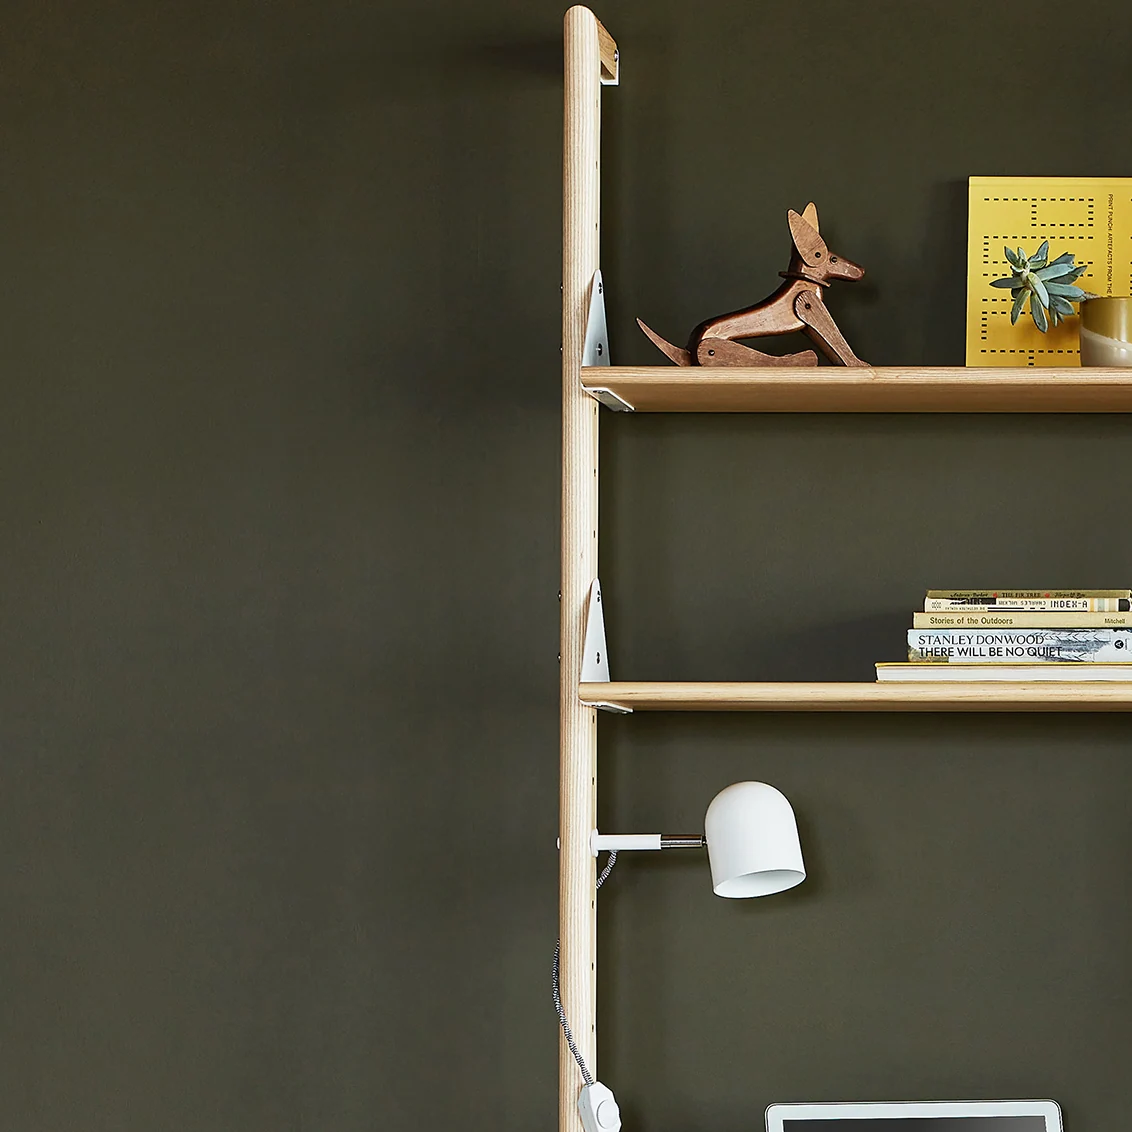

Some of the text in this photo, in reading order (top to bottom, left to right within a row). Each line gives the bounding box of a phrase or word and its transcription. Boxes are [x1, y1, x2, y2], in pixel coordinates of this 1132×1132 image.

[1050, 600, 1088, 608] INDEX-A
[930, 616, 1013, 624] Stories of the Outdoors
[918, 635, 1045, 645] STANLEY DONWOOD
[919, 647, 1062, 658] THERE WILL BE NO QUIET
